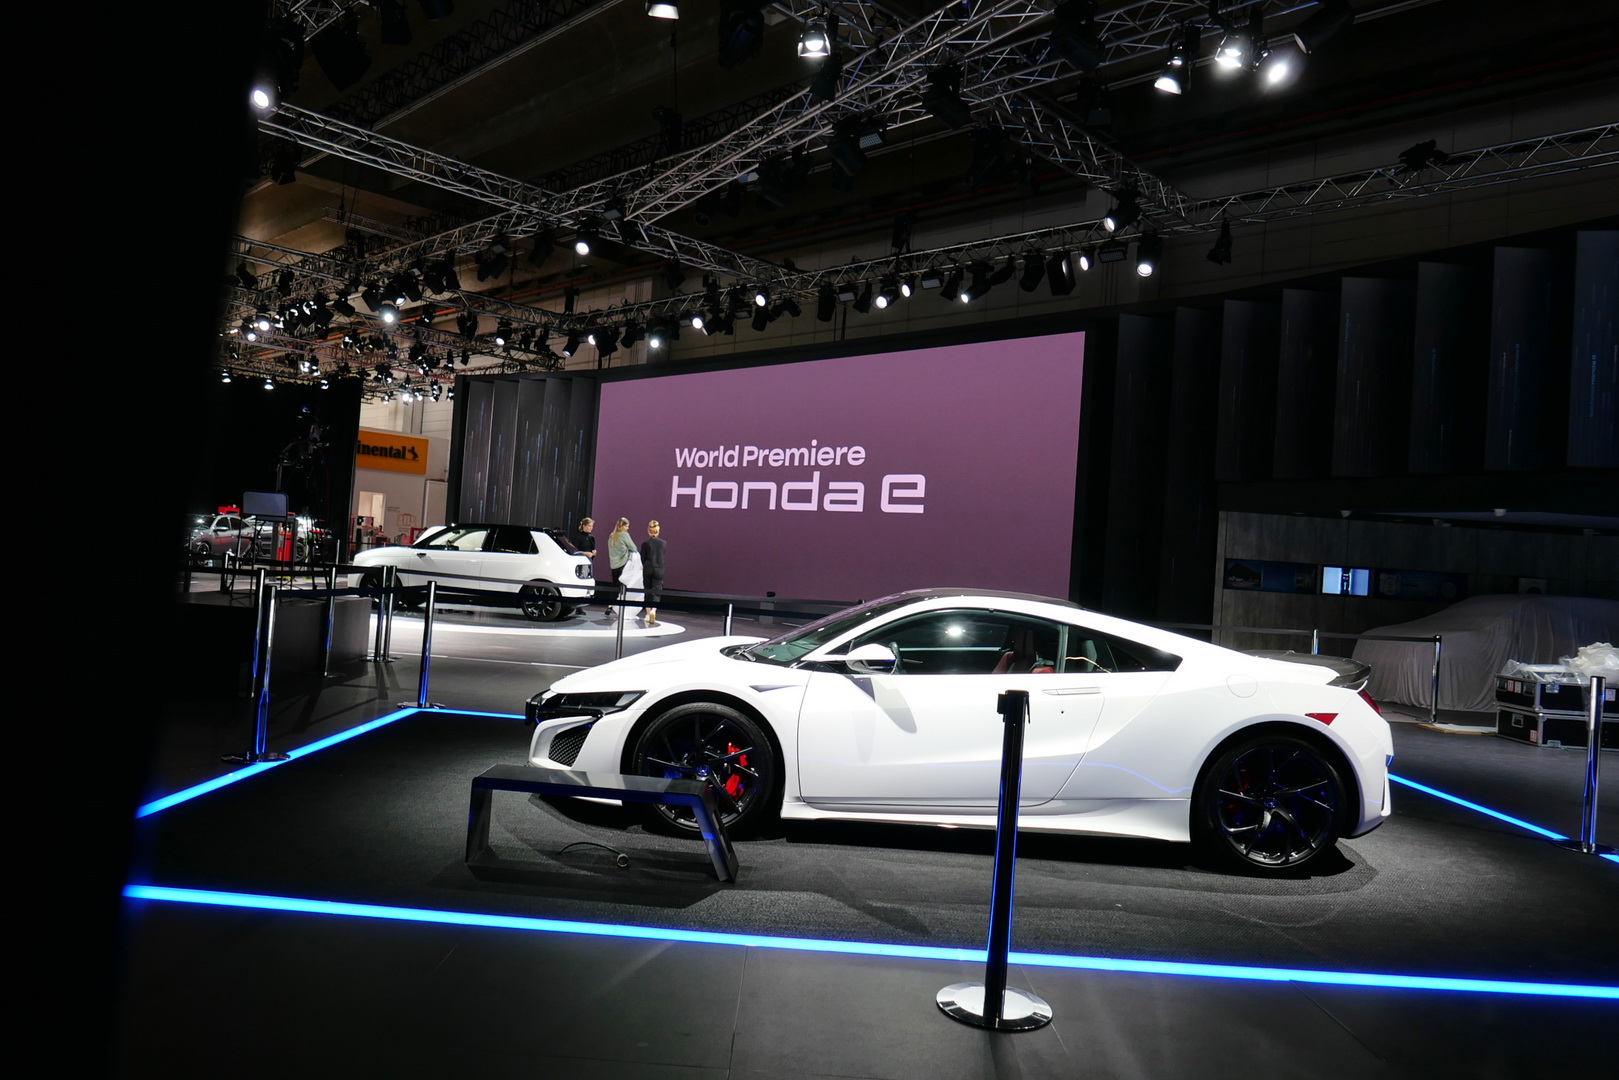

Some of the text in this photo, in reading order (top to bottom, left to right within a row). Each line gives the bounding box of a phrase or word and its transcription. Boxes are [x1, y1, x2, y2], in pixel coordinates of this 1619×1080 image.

[675, 439, 866, 468] World Premiere
[670, 471, 926, 514] Honda e
